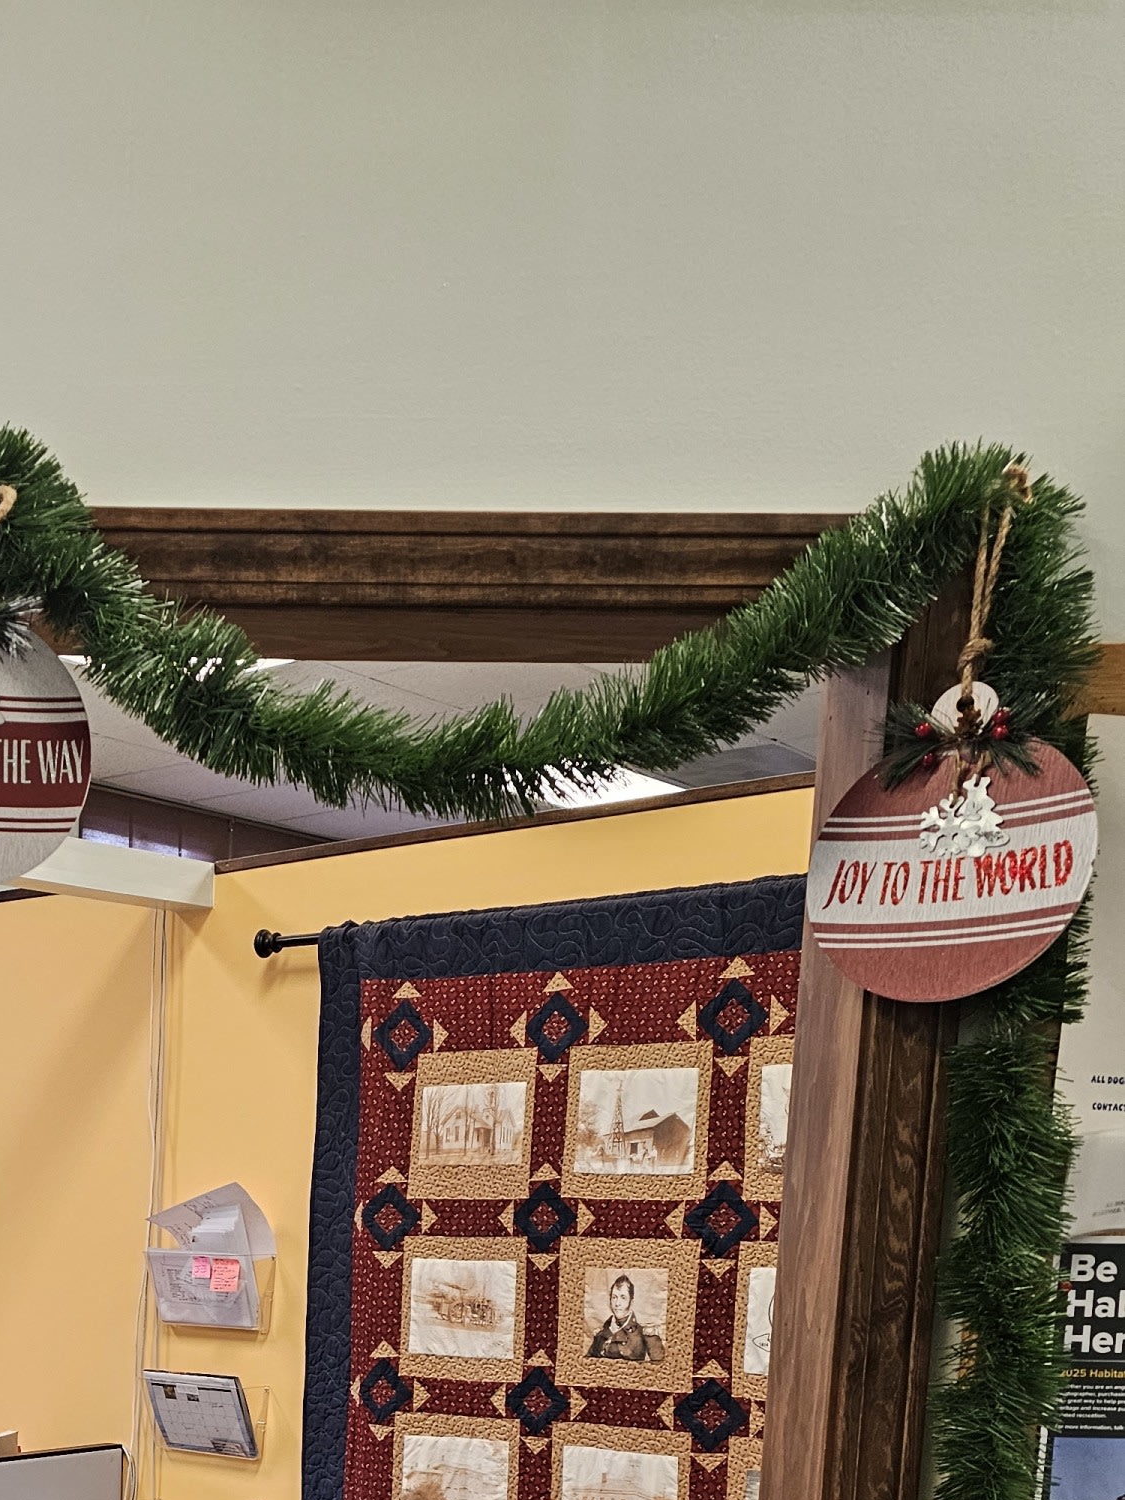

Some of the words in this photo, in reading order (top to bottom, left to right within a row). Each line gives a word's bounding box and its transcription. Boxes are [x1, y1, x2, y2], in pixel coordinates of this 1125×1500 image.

[37, 739, 84, 785] WAY
[822, 859, 877, 910] JOY
[879, 860, 910, 906] TO
[918, 856, 967, 904] THE
[973, 839, 1074, 899] WORLD
[1090, 1075, 1105, 1084] ALL
[1092, 1102, 1125, 1112] CONTAC
[1070, 1253, 1118, 1283] Be
